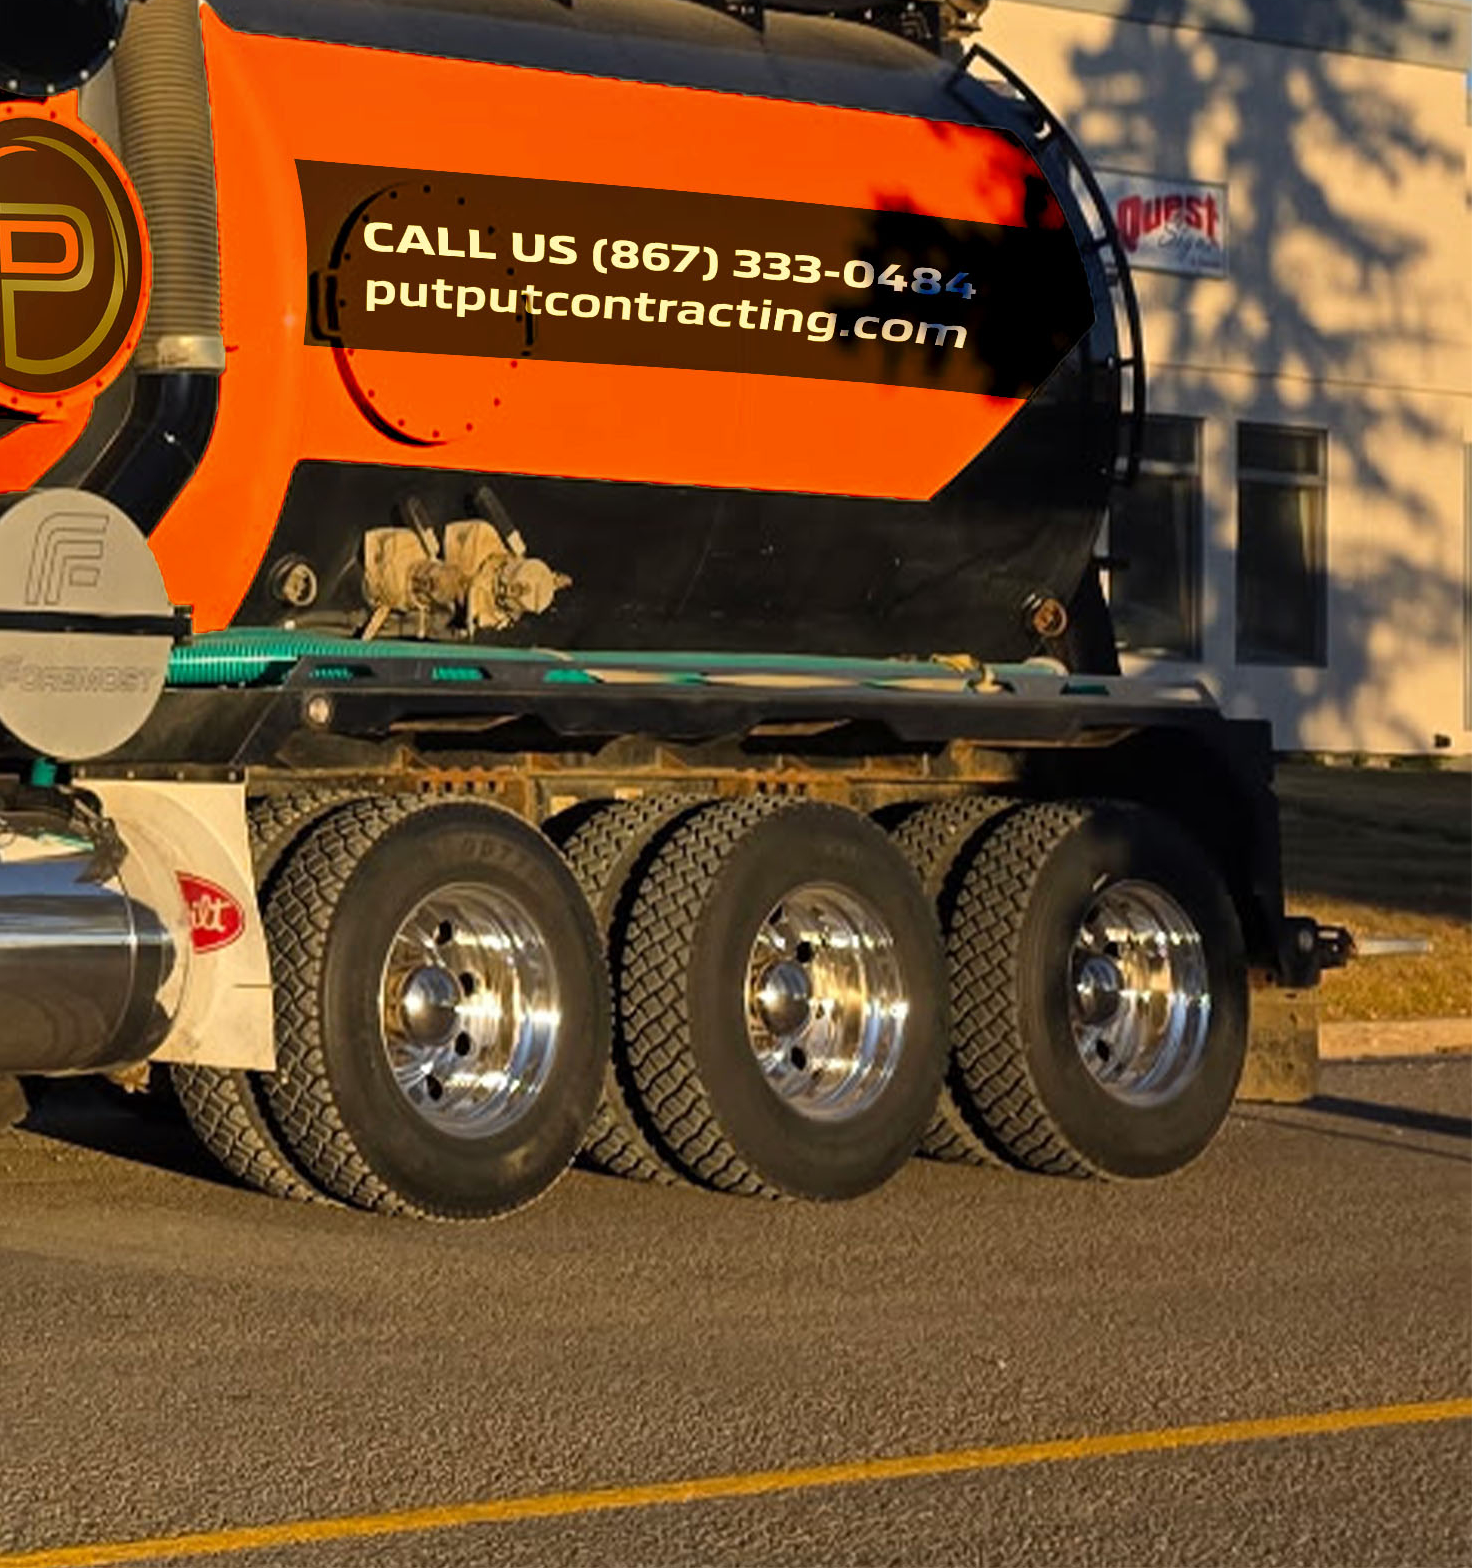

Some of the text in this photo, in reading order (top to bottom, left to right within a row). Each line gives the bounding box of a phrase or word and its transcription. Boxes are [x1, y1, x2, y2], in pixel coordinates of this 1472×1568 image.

[363, 222, 977, 300] CALL US (867) 333-0484
[365, 278, 967, 349] putputcontracting.com
